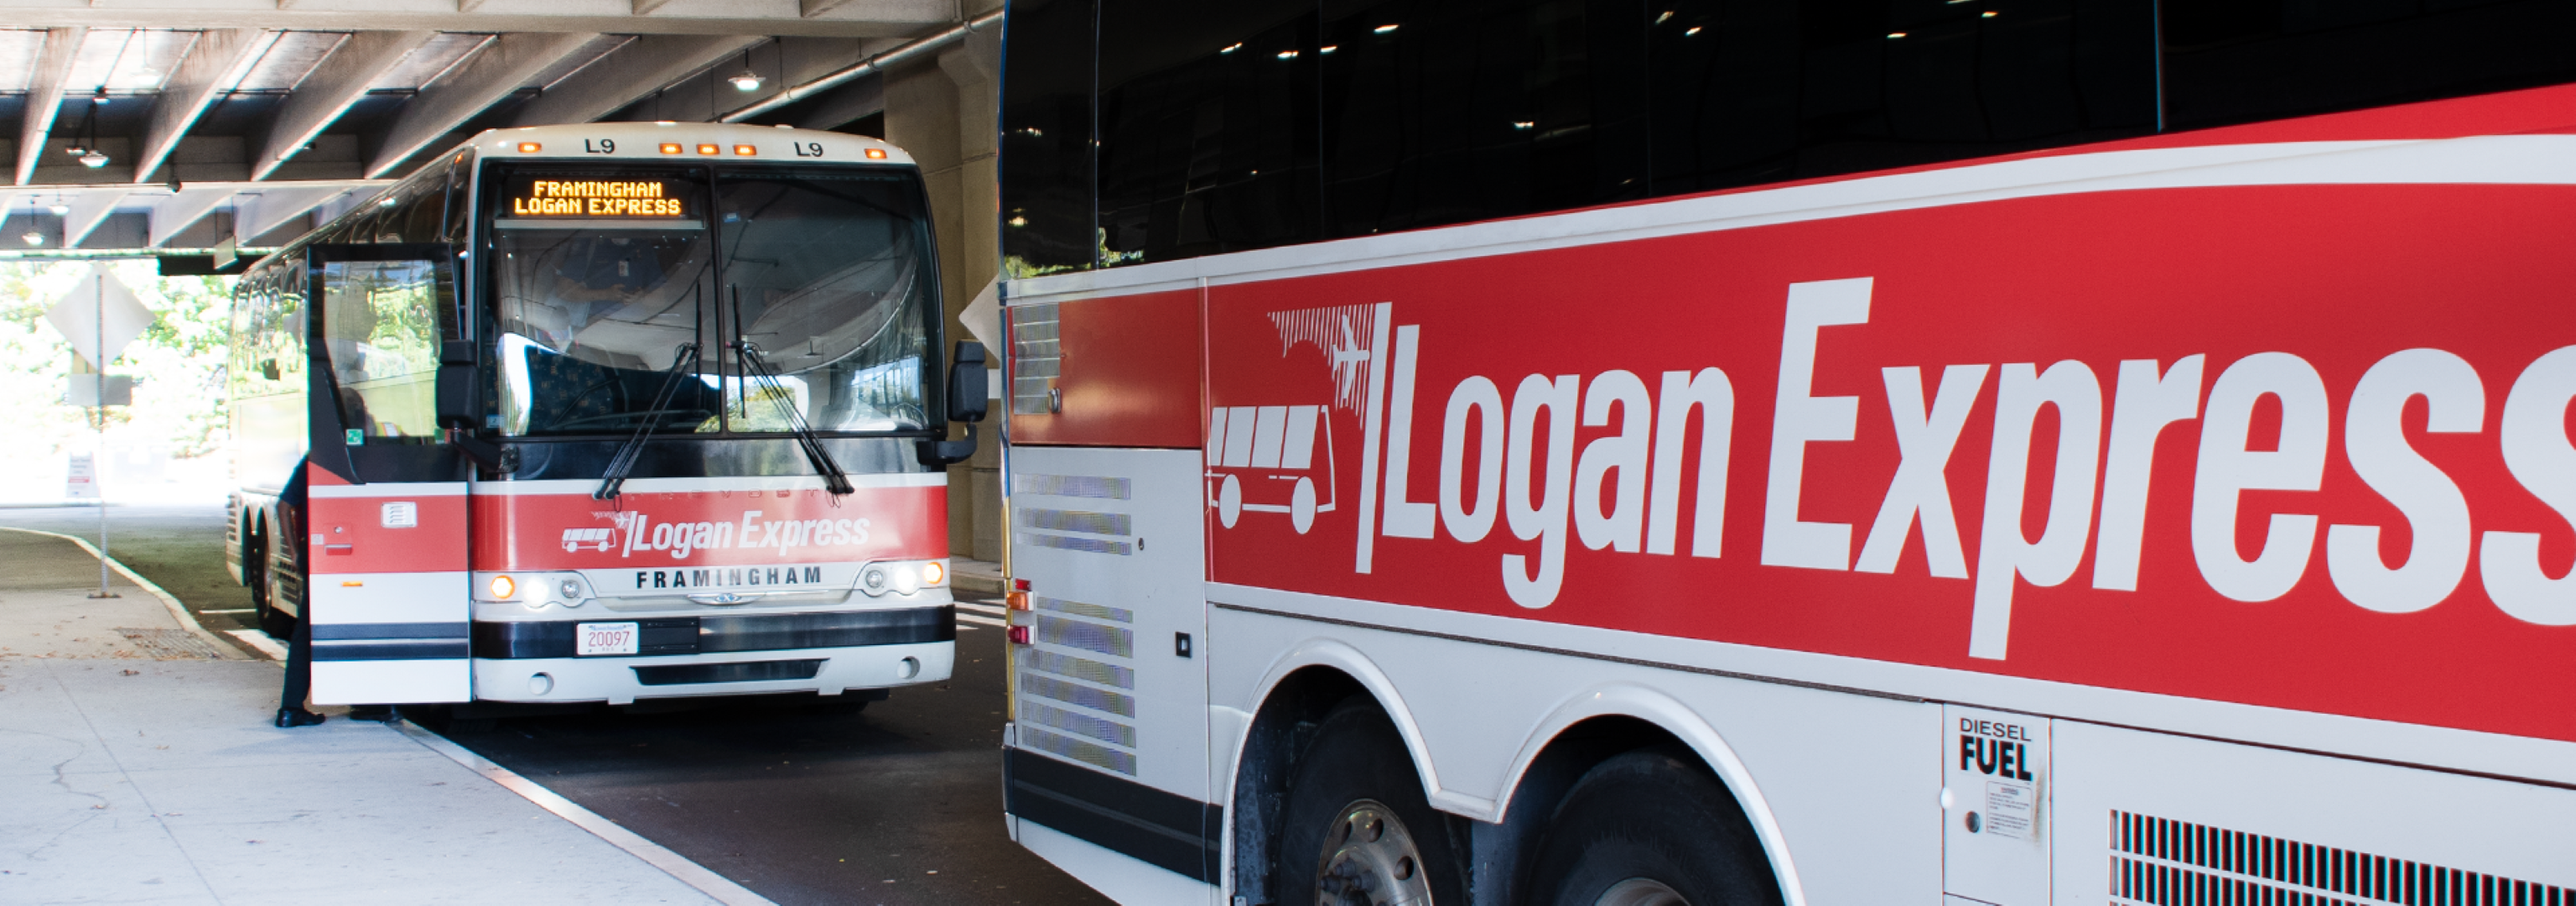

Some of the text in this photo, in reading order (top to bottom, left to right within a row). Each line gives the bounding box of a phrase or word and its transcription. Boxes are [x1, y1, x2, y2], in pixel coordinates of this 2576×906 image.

[584, 138, 615, 154] L9
[794, 142, 823, 157] L9
[534, 180, 662, 197] FRAMINGHAM
[515, 198, 681, 216] LOGAN EXPRESS
[1383, 276, 2576, 661] Logan Express
[633, 511, 870, 559] Logan Express
[636, 566, 821, 589] FRAMINGHAM
[589, 631, 630, 647] 20097
[1960, 717, 2031, 742] DIESEL
[1960, 734, 2033, 781] FUEL
